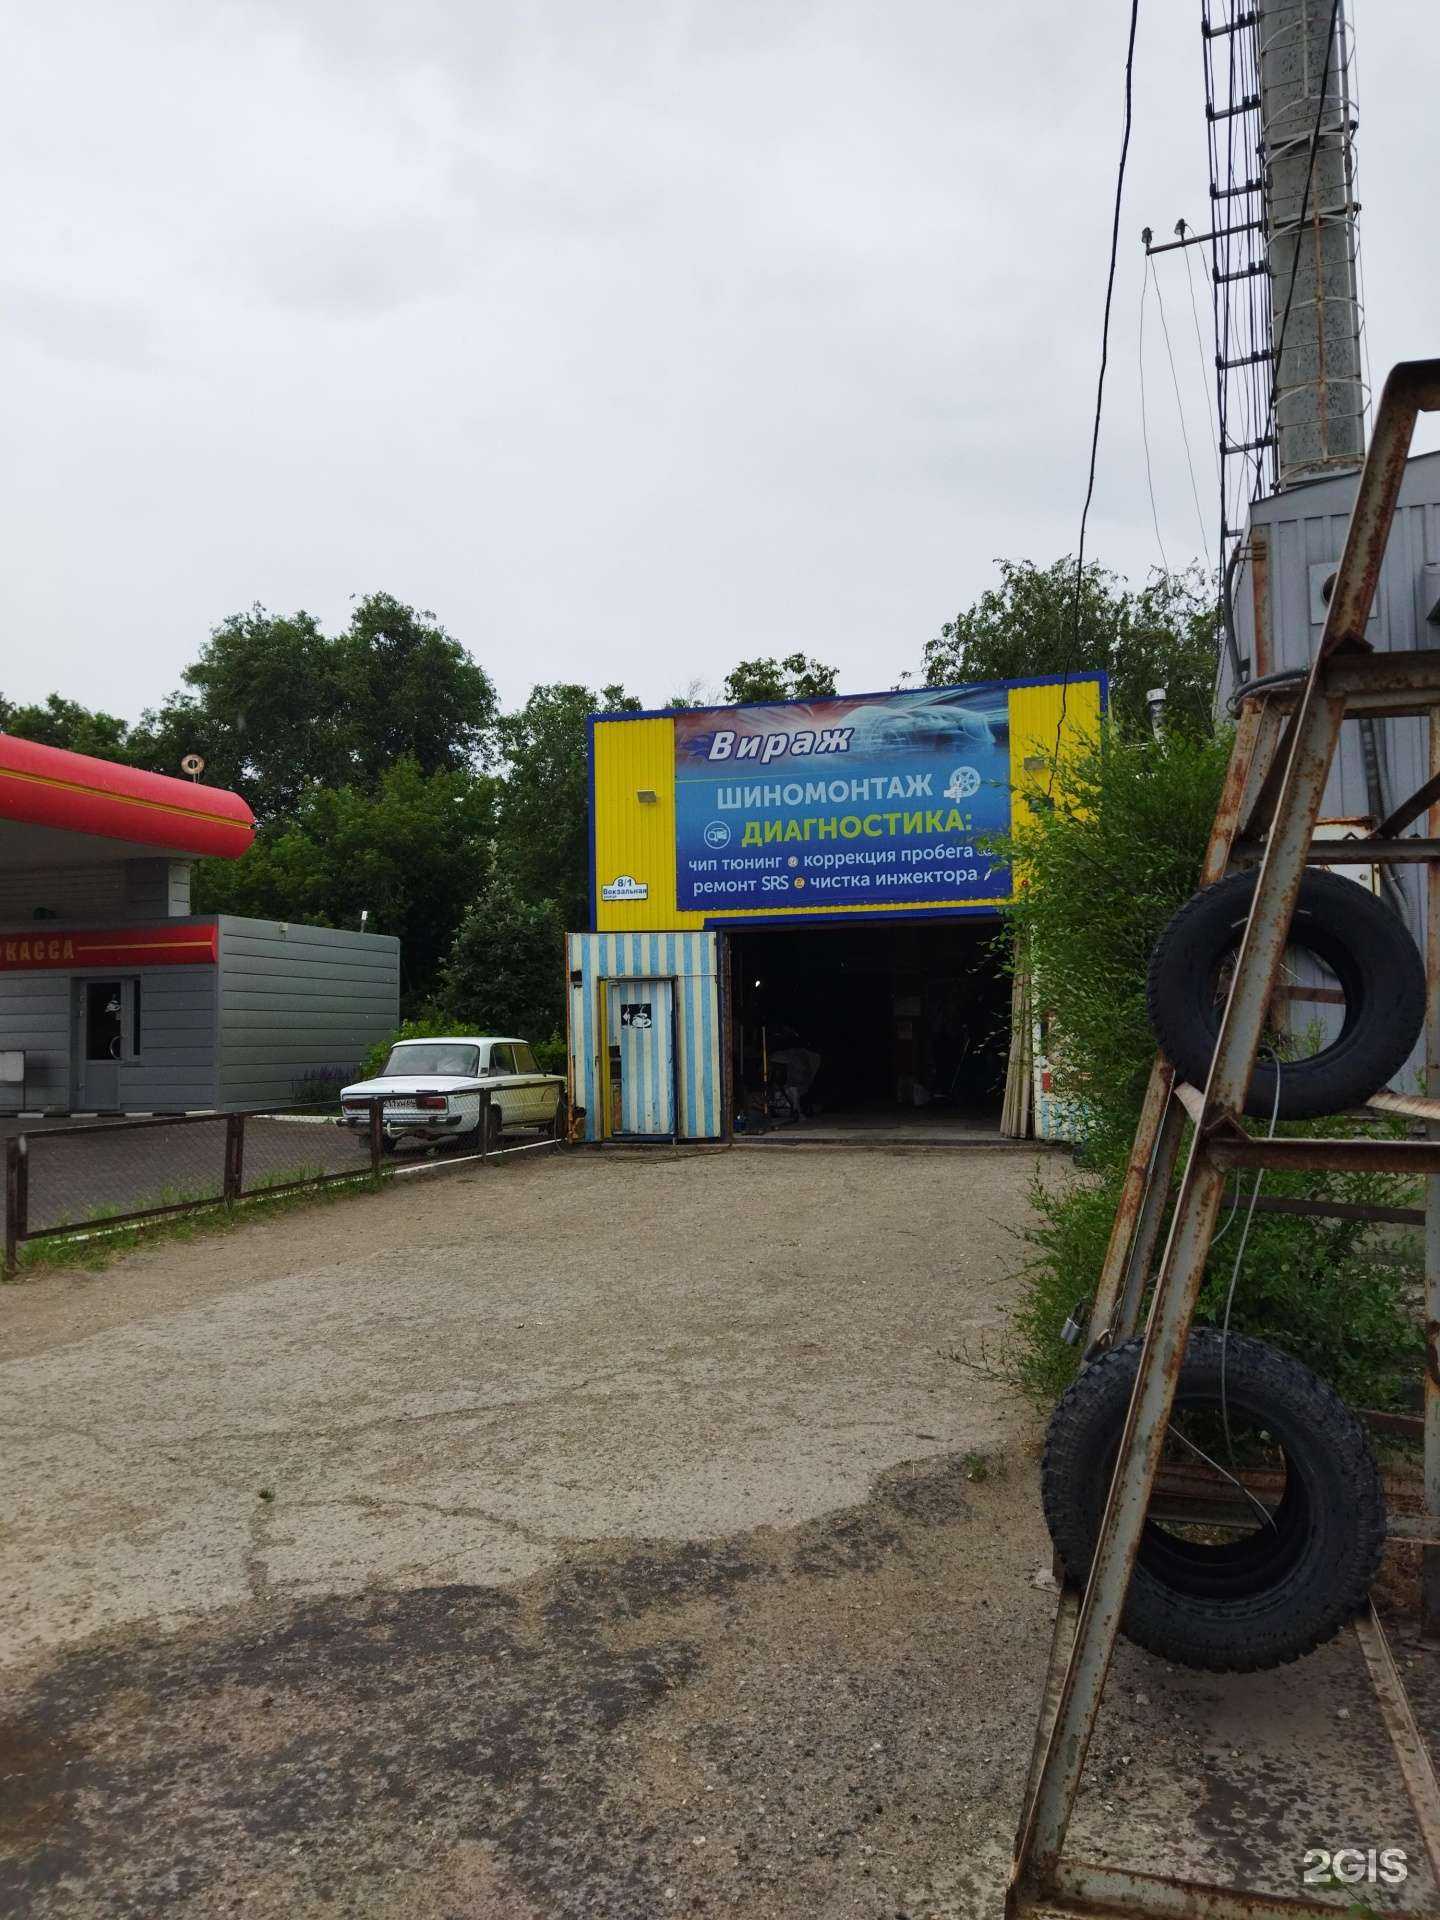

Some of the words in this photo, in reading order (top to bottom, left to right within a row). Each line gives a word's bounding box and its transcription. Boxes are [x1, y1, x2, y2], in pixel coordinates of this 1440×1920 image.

[707, 727, 855, 765] Вираж
[717, 773, 934, 810] ШИНОМОНТАЖ
[741, 809, 973, 848] ДИАГНОСТИКА:
[688, 859, 717, 872] чип
[722, 855, 783, 870] тюнинг
[804, 850, 896, 869] коррекция
[901, 842, 973, 864] пробега
[617, 878, 632, 887] 8/1
[693, 879, 756, 896] ремонт
[761, 875, 789, 892] SRS
[810, 874, 870, 890] чистка
[875, 868, 978, 886] инжектора
[6, 940, 74, 961] КАССА
